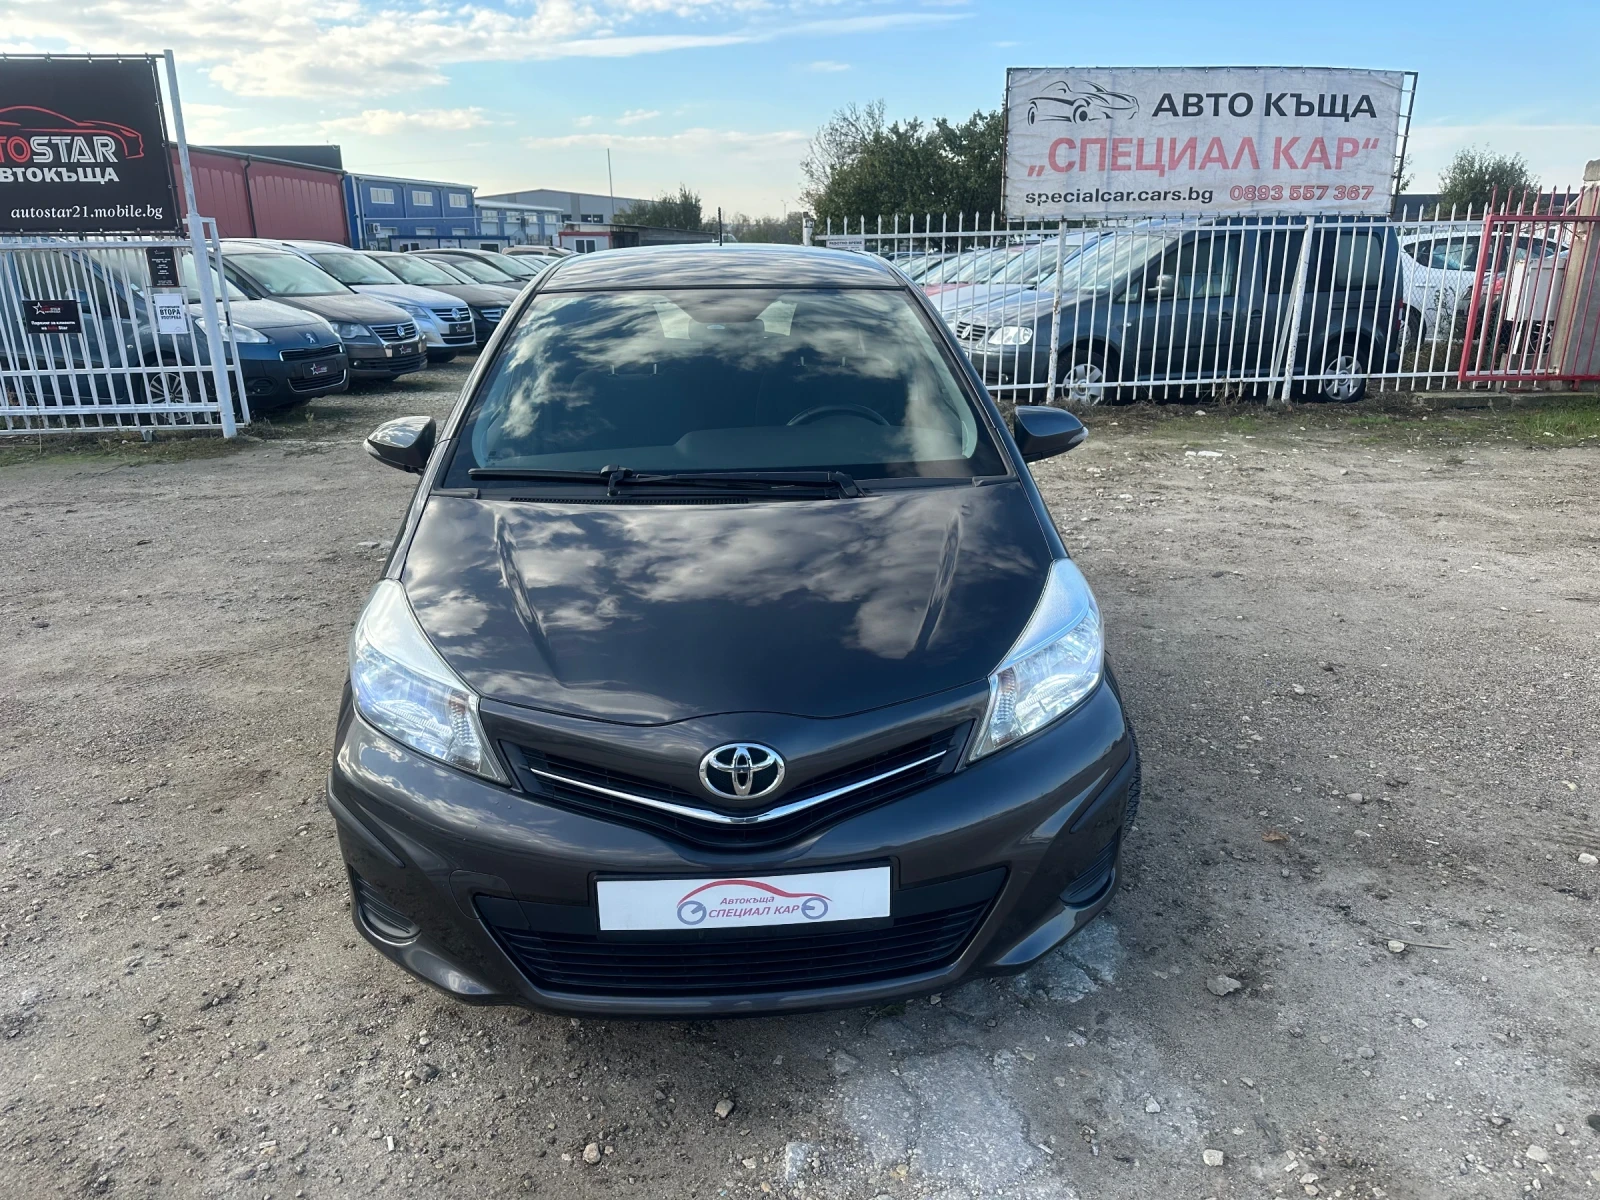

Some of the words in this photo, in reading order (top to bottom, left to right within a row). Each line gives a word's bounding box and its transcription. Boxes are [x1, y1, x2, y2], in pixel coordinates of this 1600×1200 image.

[1152, 92, 1254, 117] АВТО
[1264, 92, 1377, 122] КЪЩА
[1025, 187, 1213, 206] specialcar.cars.bg
[1229, 184, 1284, 201] 0893
[1288, 185, 1330, 201] 557
[1332, 185, 1375, 201] 367
[11, 204, 163, 219] autostar21.mobile.bg
[159, 308, 181, 316] ВТОРА
[720, 896, 775, 905] Автокъща
[708, 907, 771, 918] СПЕЦИАЛ
[773, 904, 800, 915] КАР
